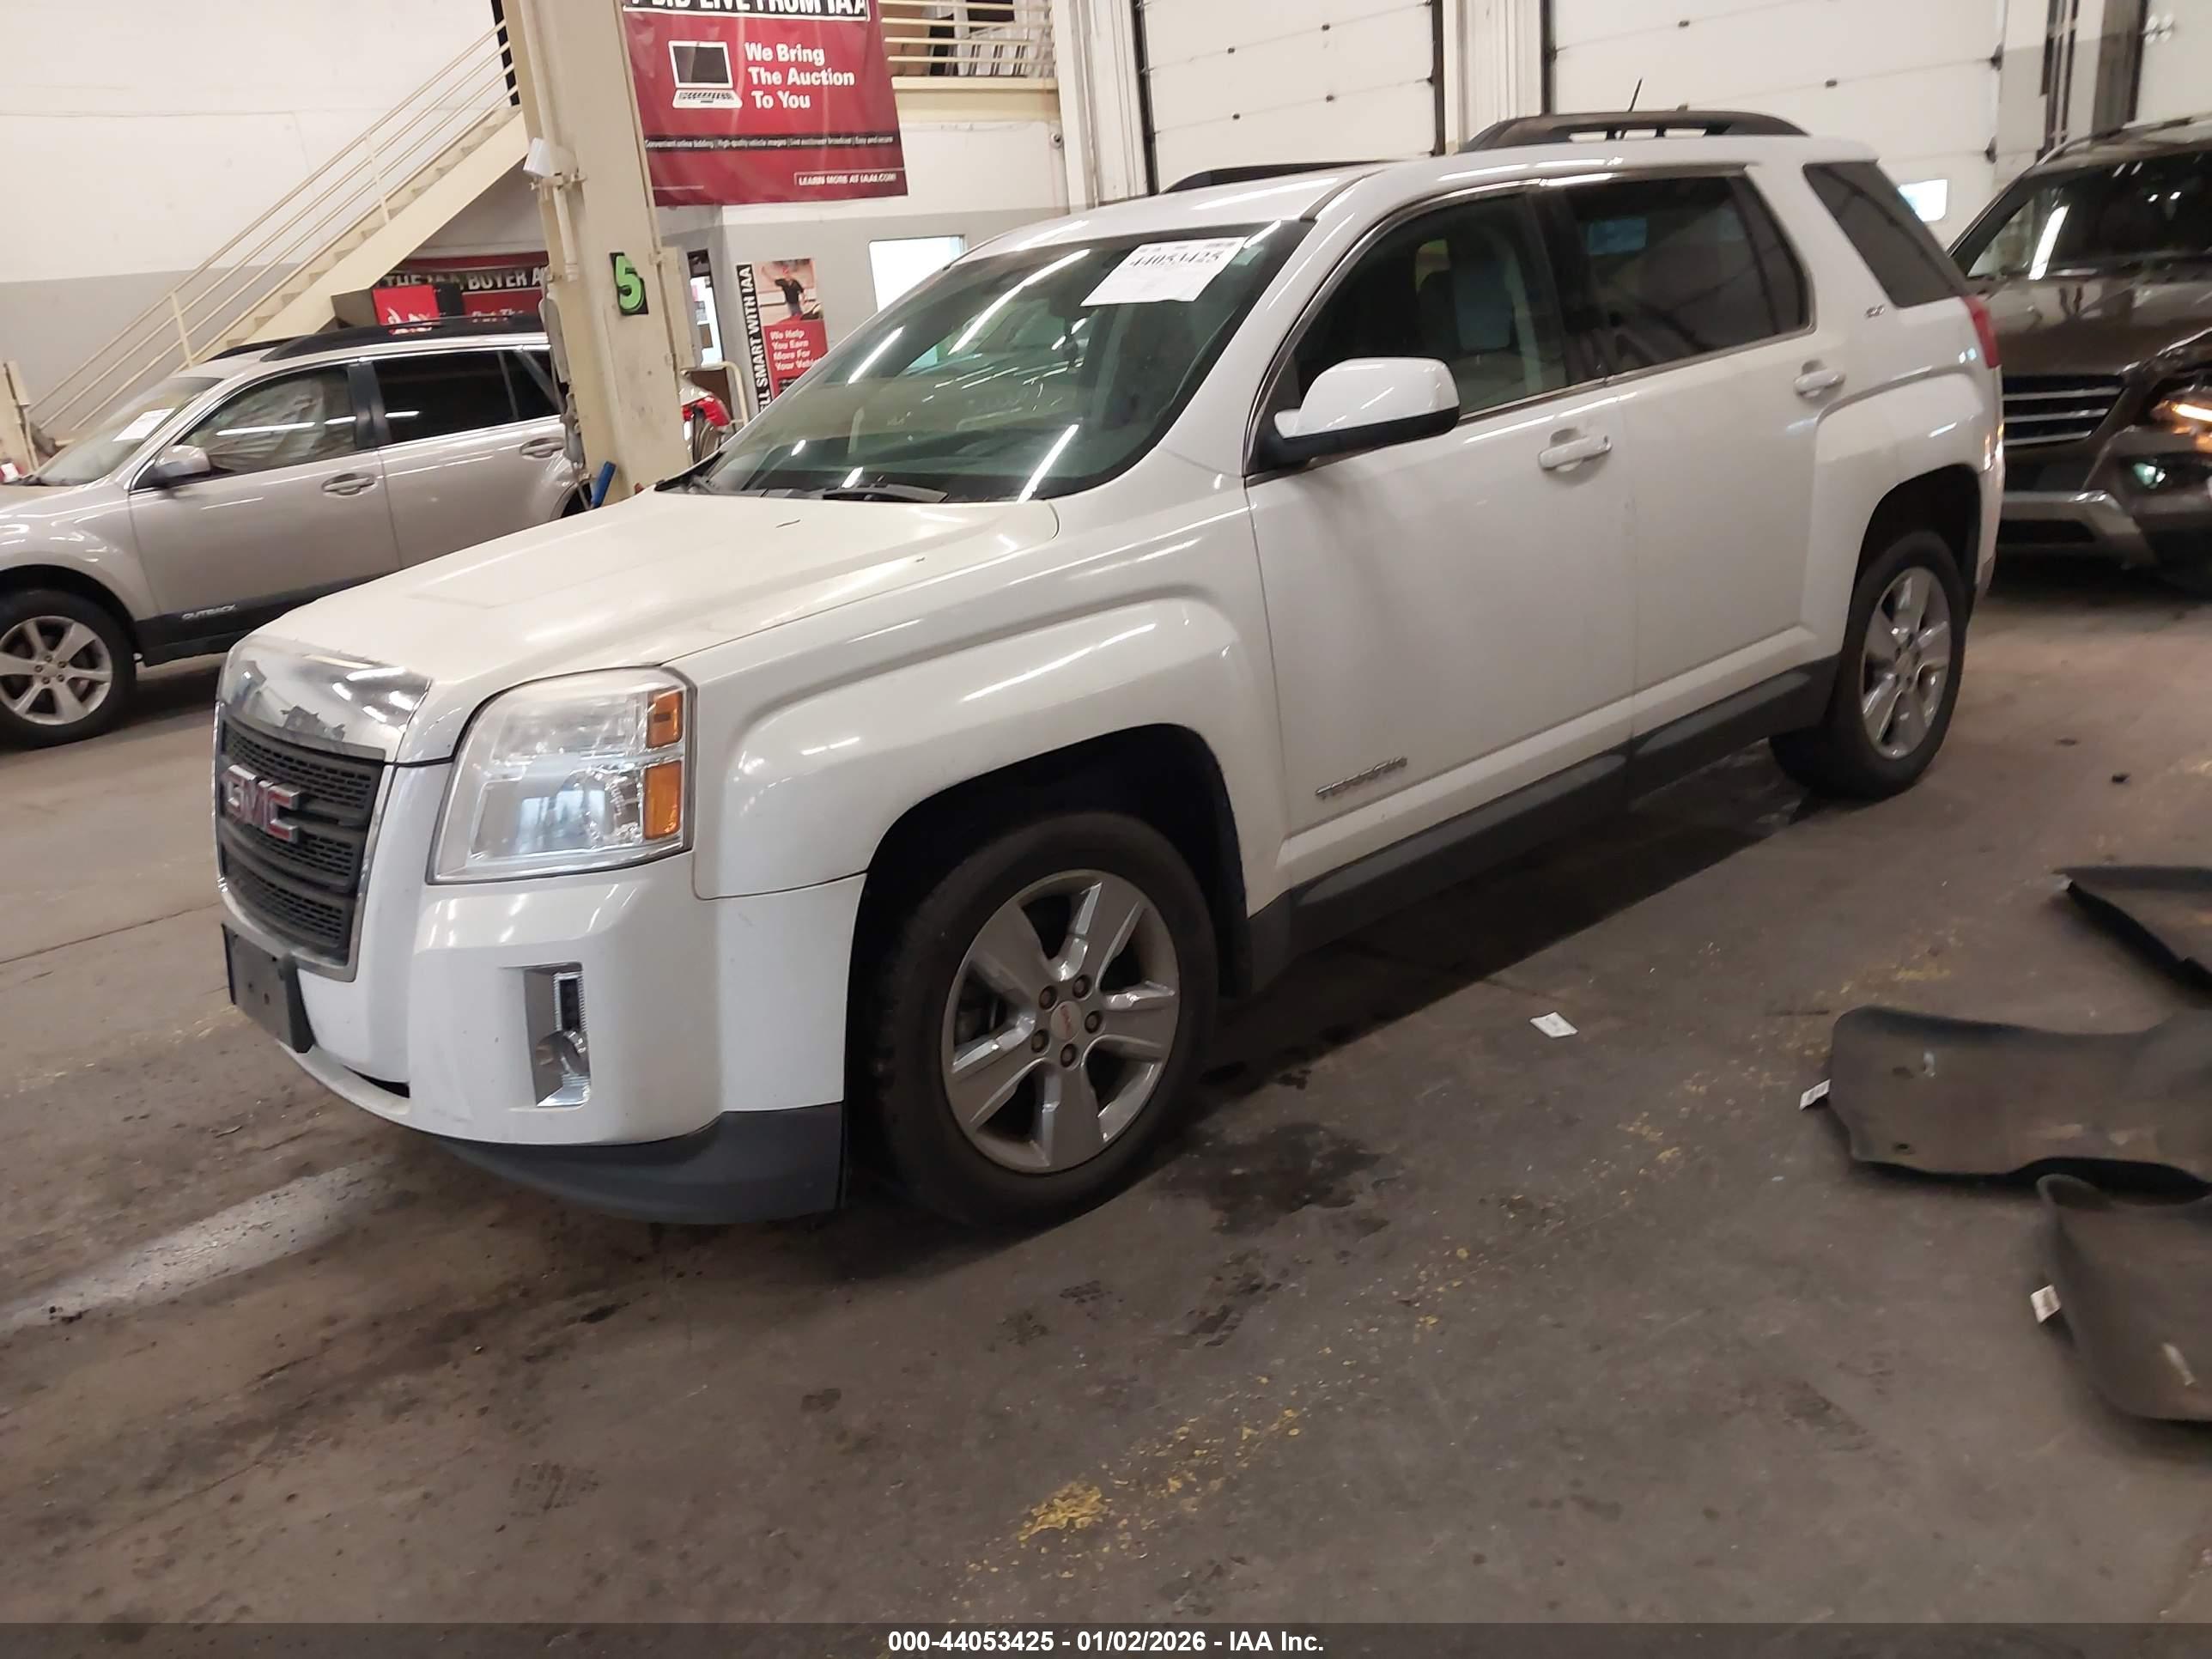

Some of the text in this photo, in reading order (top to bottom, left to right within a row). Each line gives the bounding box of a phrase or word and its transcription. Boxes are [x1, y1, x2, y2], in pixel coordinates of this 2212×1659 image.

[744, 42, 825, 66] We Bring
[748, 66, 855, 86] The Auction
[751, 89, 811, 109] To You
[614, 254, 643, 311] 5
[738, 266, 754, 293] IAA
[743, 295, 760, 335] WITH
[749, 336, 769, 388] SMART
[220, 763, 301, 842] GMC
